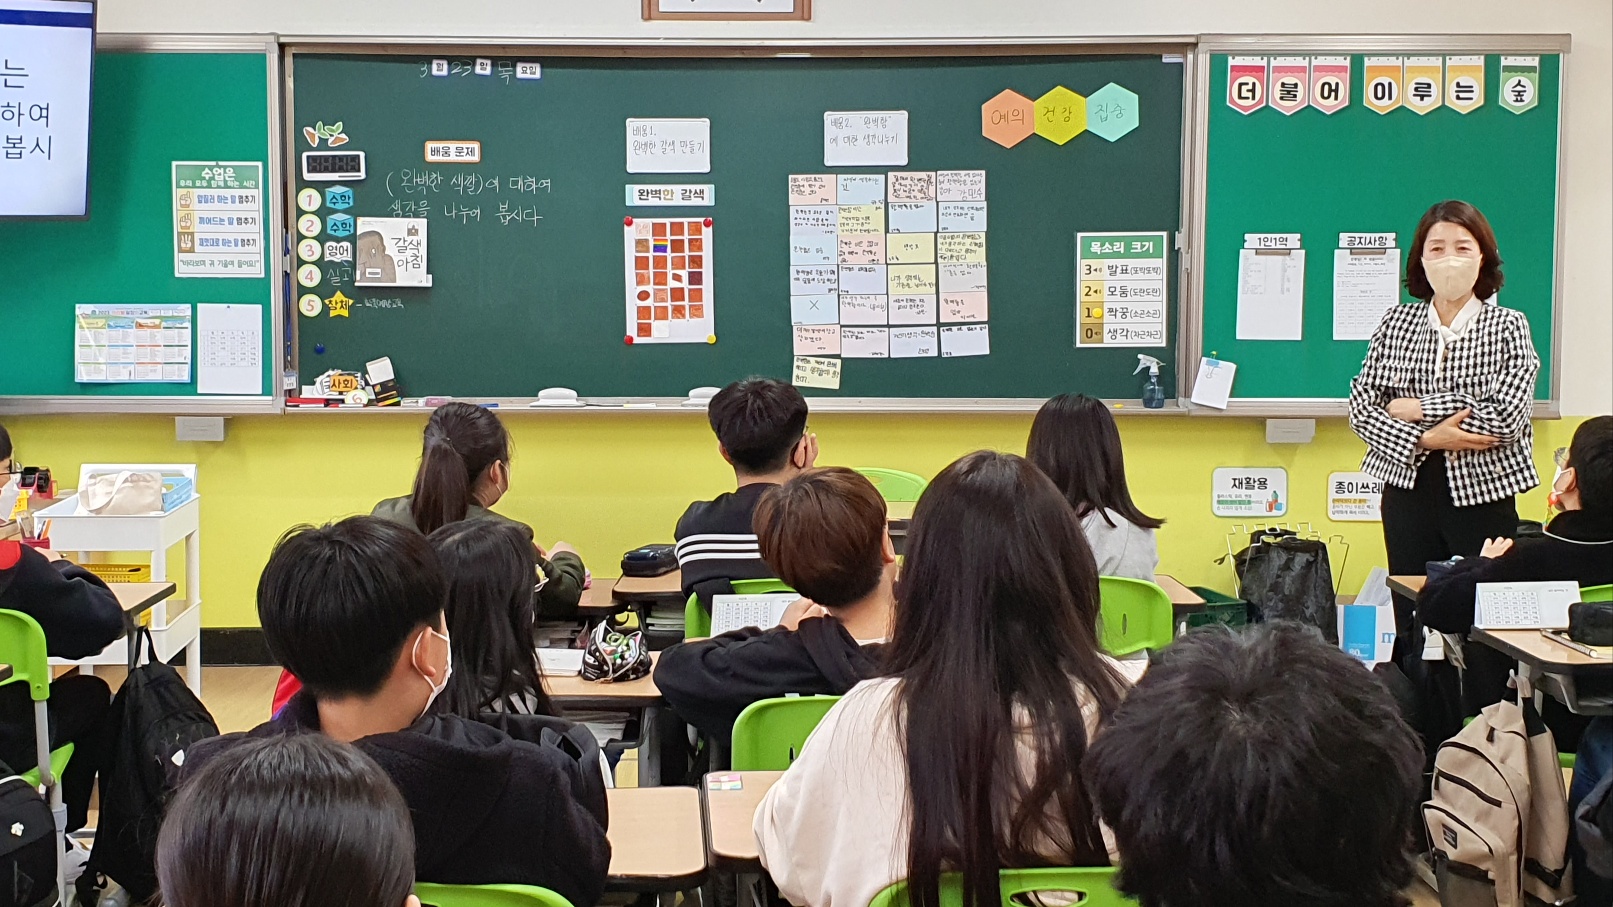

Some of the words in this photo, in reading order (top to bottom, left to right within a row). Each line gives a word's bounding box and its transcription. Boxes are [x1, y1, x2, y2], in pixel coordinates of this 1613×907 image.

[0, 59, 29, 89] 는
[420, 61, 428, 78] 3
[451, 60, 473, 77] 23
[521, 66, 537, 75] 요일
[1237, 81, 1340, 102] 더불어
[1373, 81, 1475, 102] 이루는
[1511, 80, 1527, 103] 숲
[1, 102, 50, 128] 하여
[991, 108, 1025, 126] 예의
[1043, 106, 1072, 123] 건강
[1095, 103, 1126, 122] 집중
[2, 135, 52, 160] 봅시
[430, 146, 451, 157] 배움
[454, 146, 476, 158] 문제
[633, 140, 656, 155] 완벽한
[660, 140, 676, 154] 갈색
[680, 140, 705, 154] 만들기
[201, 167, 236, 181] 수업은
[509, 175, 551, 194] 대하여
[306, 194, 313, 207] 1
[329, 195, 350, 206] 수학
[637, 188, 675, 201] 완벽한
[681, 188, 705, 201] 갈색
[387, 199, 430, 218] 생각을
[444, 201, 480, 224] 나누어
[495, 200, 543, 226] 봅시다
[305, 220, 314, 232] 2
[330, 222, 352, 233] 수학
[391, 237, 421, 253] 갈색
[1090, 242, 1125, 254] 목소리
[1130, 242, 1153, 254] 크기
[1257, 236, 1288, 247] 1인1역
[1347, 236, 1388, 247] 공지사항
[305, 245, 314, 257] 3
[327, 244, 349, 257] 영어
[396, 253, 423, 272] 아침
[305, 270, 314, 282] 4
[1084, 264, 1092, 275] 3
[1084, 286, 1092, 297] 2
[306, 299, 315, 311] 5
[328, 299, 347, 311] 창체
[1085, 307, 1092, 318] 1
[1085, 328, 1093, 339] 0
[331, 378, 354, 389] 사회
[352, 394, 362, 403] 6
[1231, 477, 1268, 490] 재활용
